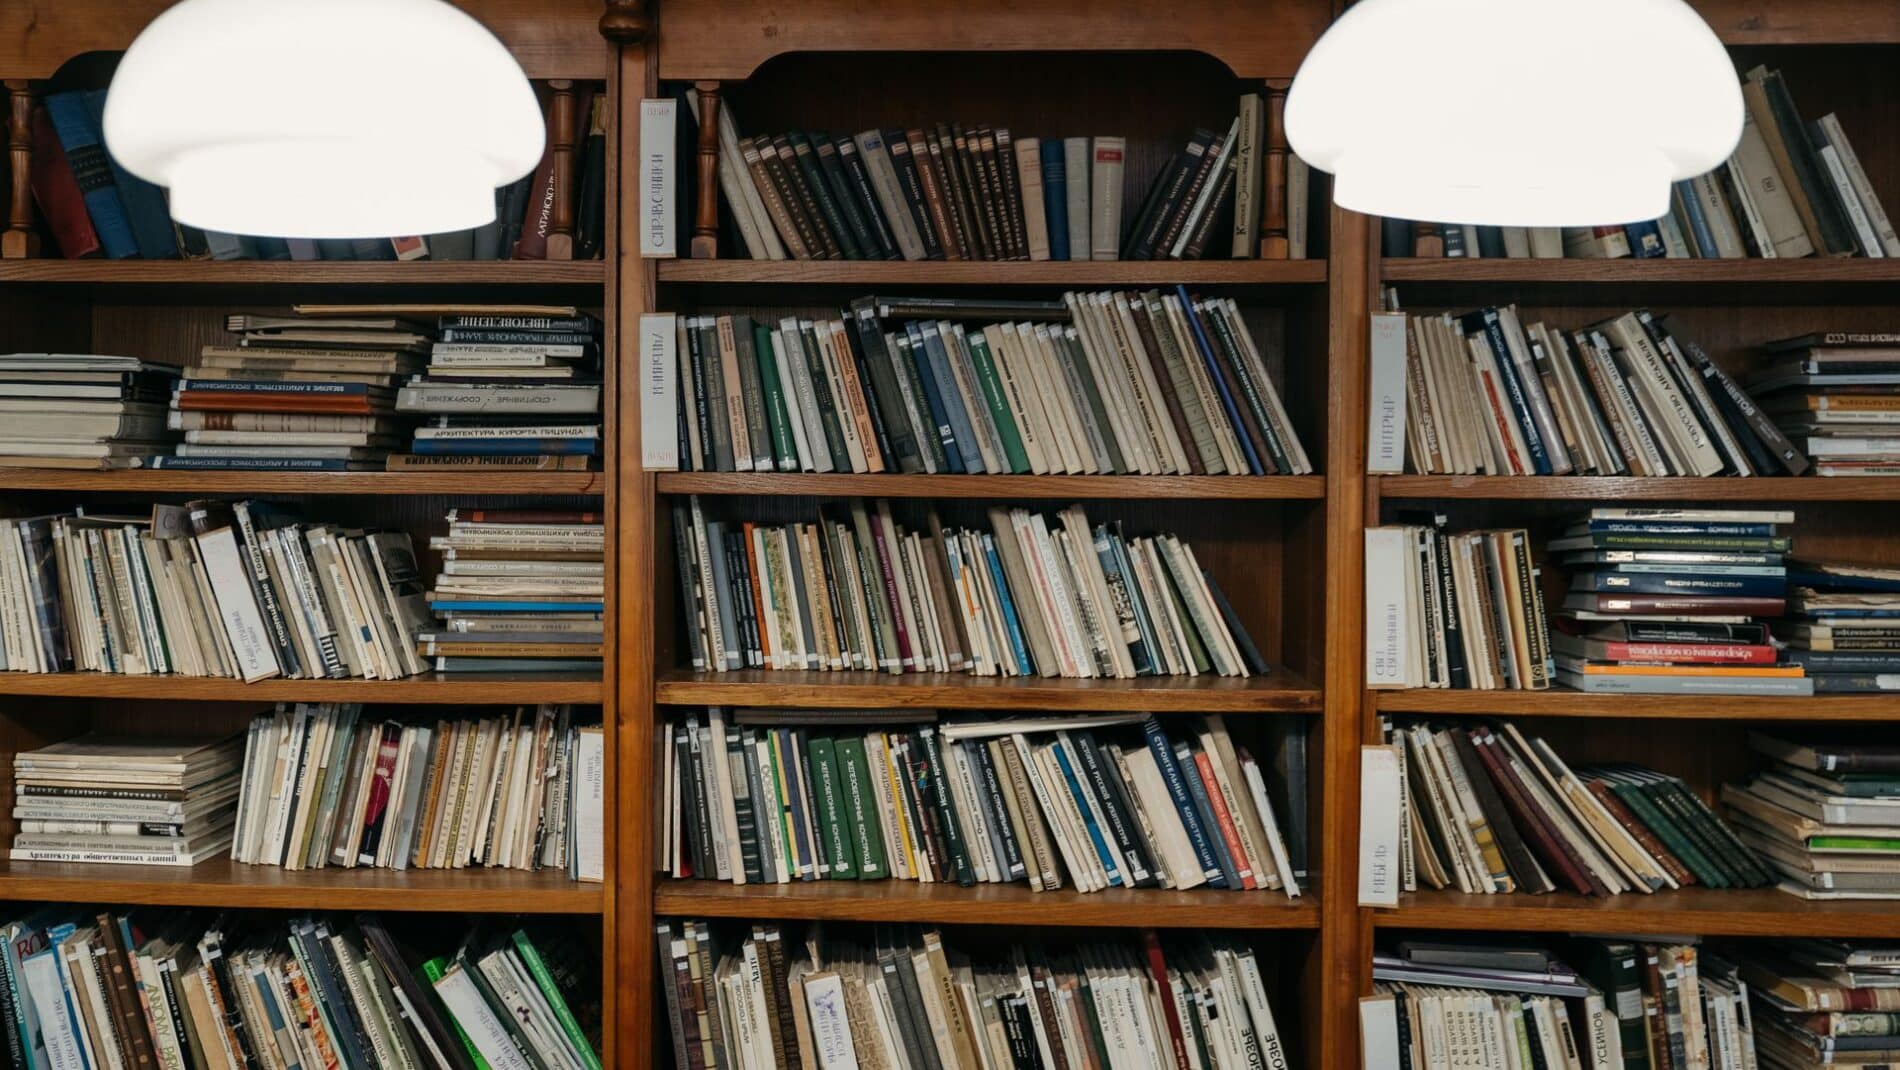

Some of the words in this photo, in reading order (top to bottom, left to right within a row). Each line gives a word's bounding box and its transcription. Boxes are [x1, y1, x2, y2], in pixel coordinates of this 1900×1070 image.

[537, 167, 558, 237] ЛАТИНСКО-
[434, 429, 495, 437] АРХИТЕКТУРА
[498, 428, 537, 436] КУРОРТА
[479, 456, 542, 464] ПОРТИВНЫЕ
[923, 734, 941, 777] архитектур
[1078, 737, 1098, 770] ИСТОРИЯ
[1092, 769, 1111, 800] РУССКОЙ
[820, 761, 837, 822] ЖЕЛЕЗОБЕТОННЫЕ
[847, 760, 864, 822] ЖЕЛЕЗОБЕТОННЫЕ
[934, 777, 948, 806] История
[1150, 734, 1187, 802] СТРОИТЕЛЬНЫЕ
[1181, 803, 1216, 867] КОНСТРУКЦИИ
[29, 852, 80, 861] Архитектура
[733, 984, 746, 1022] ГОЛОСОВ
